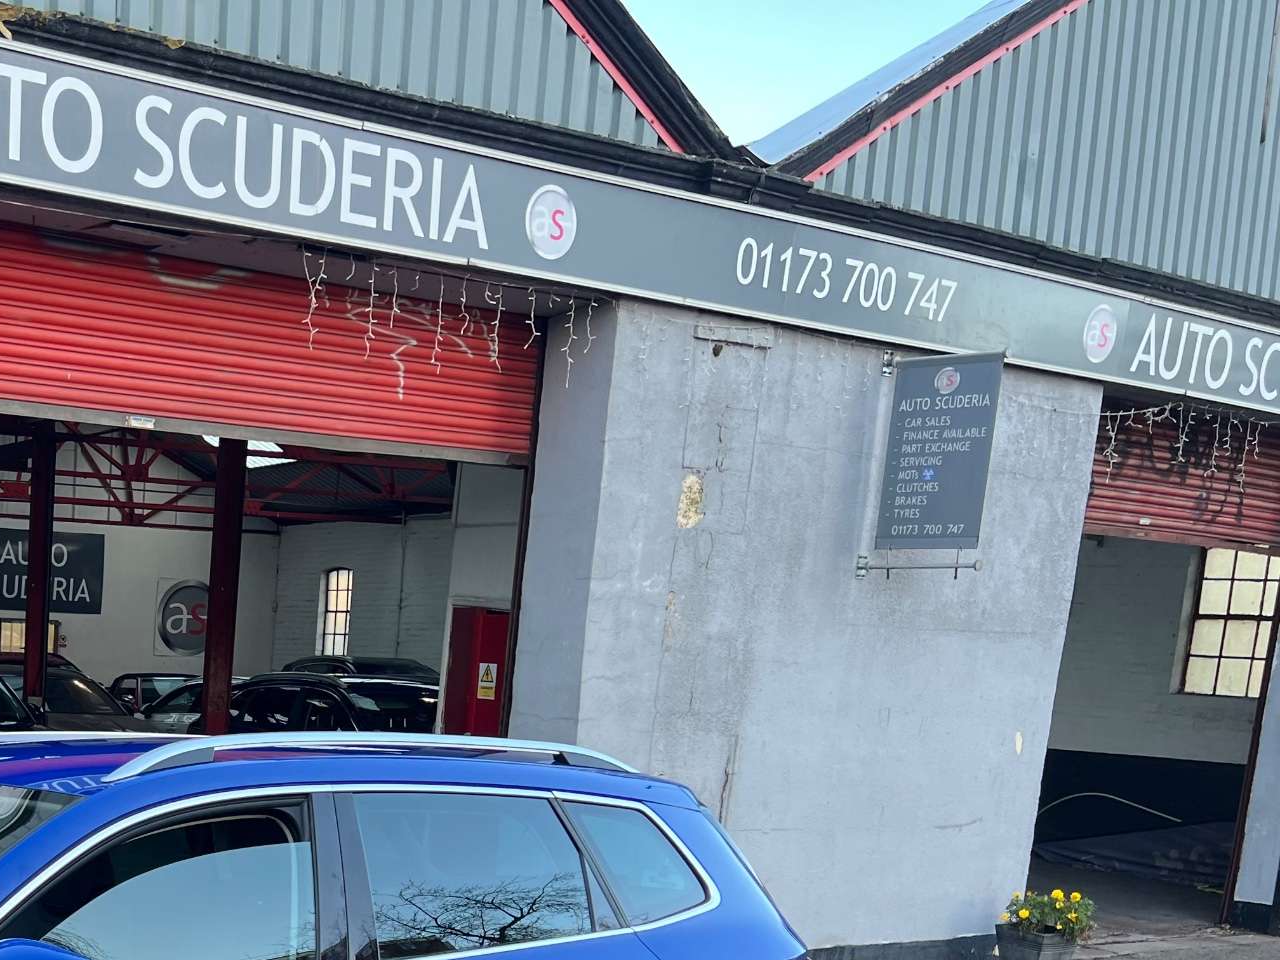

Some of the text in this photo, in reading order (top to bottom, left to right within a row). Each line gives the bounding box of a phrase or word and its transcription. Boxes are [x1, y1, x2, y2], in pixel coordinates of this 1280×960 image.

[133, 94, 489, 250] SCUDERIA
[736, 237, 958, 322] 01173 700 747
[1129, 313, 1233, 390] AUTO
[899, 394, 991, 412] AUTO SCUDERIA
[904, 416, 952, 428] CAR SALES
[903, 427, 987, 441] FINANCE AVAILABLE
[901, 441, 971, 454] PART EXCHANGE
[899, 456, 942, 468] SERVICING
[896, 482, 939, 493] CLUTCHES
[894, 495, 928, 506] BRAKES
[893, 508, 920, 519] TYRES
[891, 523, 965, 536] 01173 700 747
[0, 540, 68, 567] AUO
